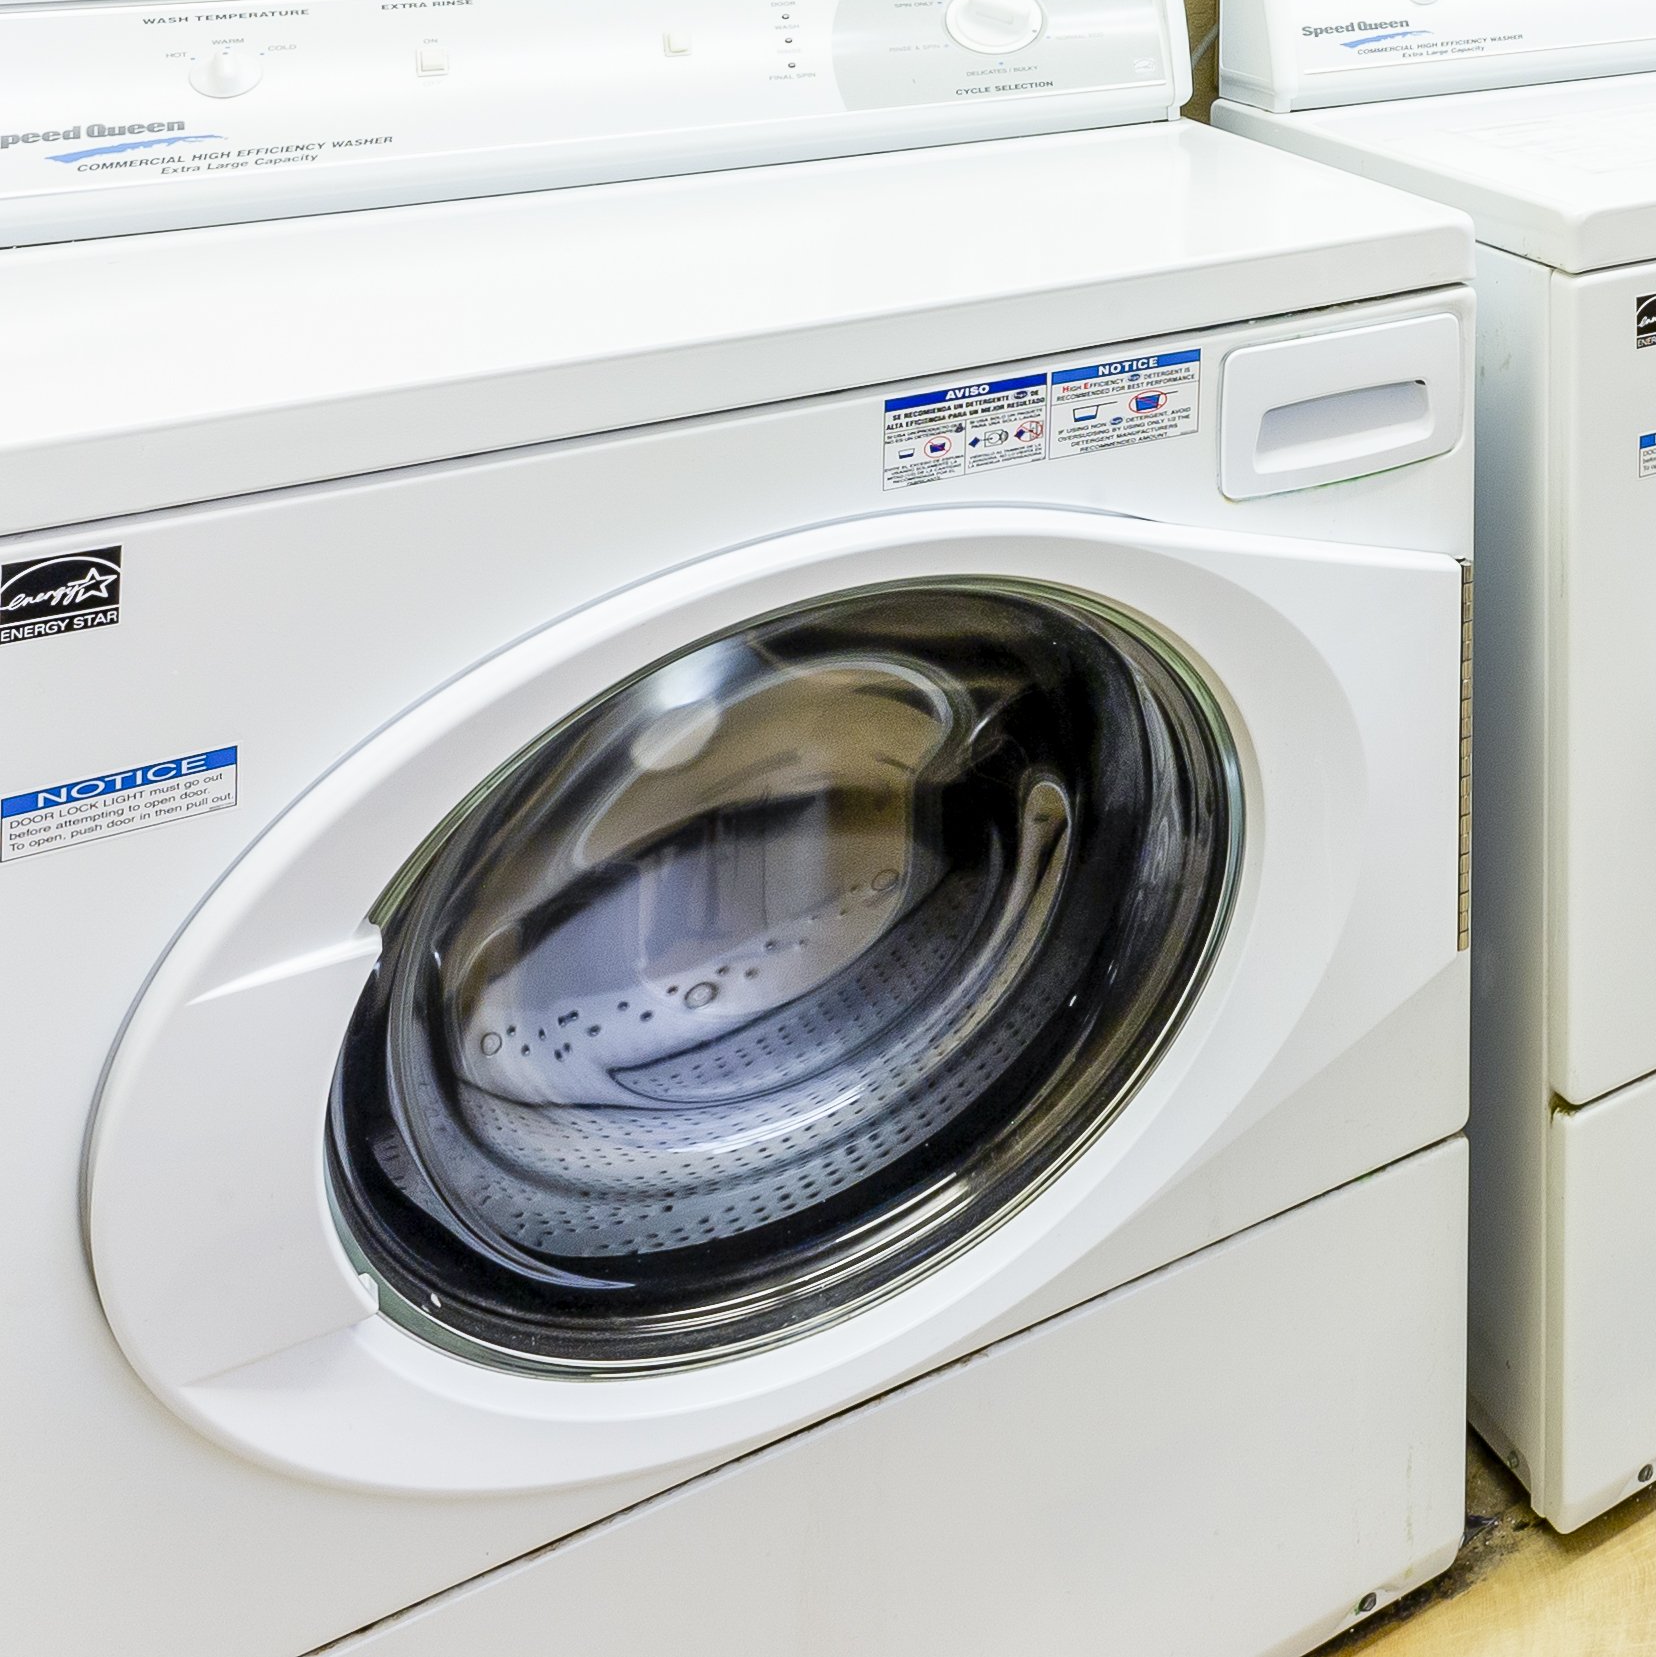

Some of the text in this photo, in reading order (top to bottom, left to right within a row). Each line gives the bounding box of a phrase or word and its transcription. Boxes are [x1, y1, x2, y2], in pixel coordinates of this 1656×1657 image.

[381, 1, 427, 11] EXTRA
[142, 9, 310, 25] WASH TEMPERATURE
[1302, 19, 1410, 38] Speed Queen
[211, 37, 245, 46] WARM
[267, 43, 297, 52] COLD
[1357, 44, 1413, 55] COMMERCIAL
[1417, 42, 1438, 50] HIGH
[1440, 37, 1487, 48] EFFICIENCY
[1426, 48, 1448, 56] Large
[1450, 45, 1485, 54] Capacity
[955, 80, 1054, 96] CYCLE SELECTION
[0, 120, 186, 149] peed Queen
[77, 136, 394, 172] COMMERCIAL HIGH EFFICIENCY WASHER
[160, 152, 319, 175] Extra Large Capacity
[1098, 357, 1158, 376] NOTICE
[1144, 369, 1182, 380] DETERGENT
[946, 385, 990, 400] AVISO
[1056, 388, 1110, 402] RECOMMENDED
[1128, 382, 1144, 390] BEST
[1146, 374, 1195, 386] PERFORMANCE
[886, 422, 904, 431] ALTA
[1147, 418, 1164, 426] ONLY
[0, 610, 118, 642] ENERGY STAR
[37, 754, 207, 808] NOTICE
[10, 773, 223, 830] DOOR LOCK LIGHT must go out
[9, 787, 210, 841] before attempting to open door.
[9, 842, 25, 852] To
[29, 834, 66, 848] open,
[70, 823, 103, 840] push
[106, 816, 136, 828] door
[140, 812, 151, 820] in
[155, 804, 182, 818] then
[186, 797, 208, 812] pull
[212, 792, 234, 804] out.
